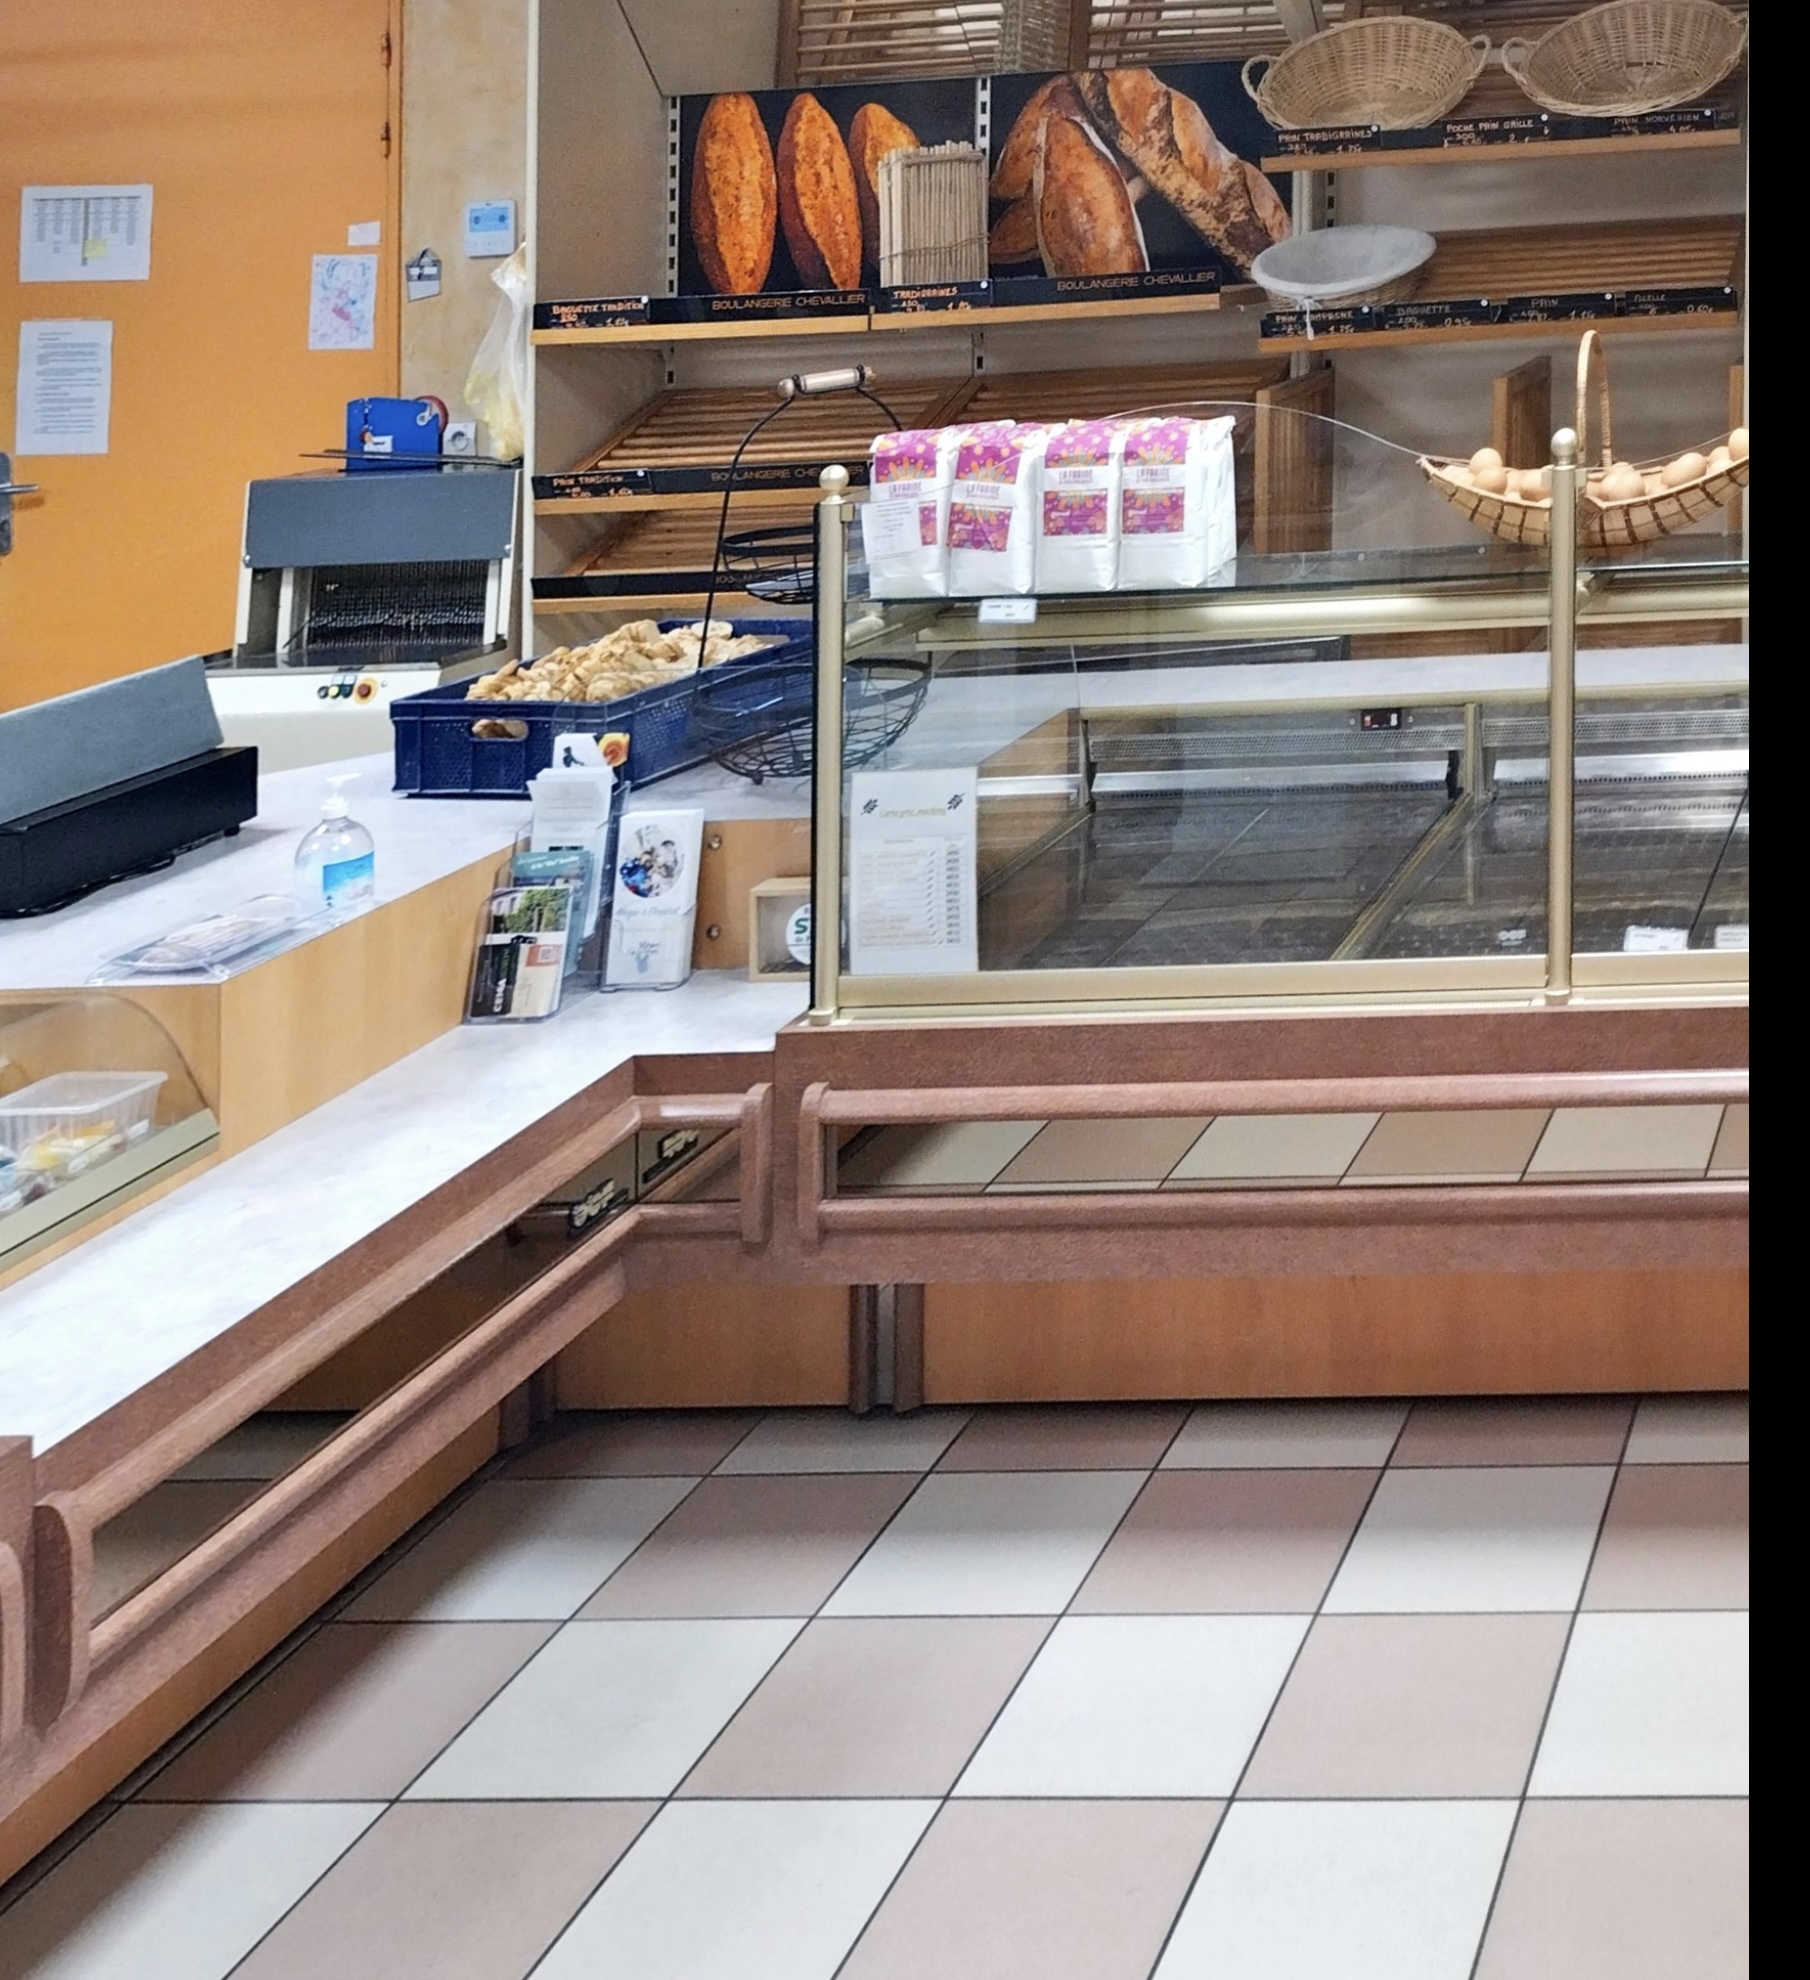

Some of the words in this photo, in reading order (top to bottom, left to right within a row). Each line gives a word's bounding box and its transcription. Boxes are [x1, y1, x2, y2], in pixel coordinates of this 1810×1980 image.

[1478, 120, 1499, 131] PAIN
[1278, 133, 1300, 143] PAIN
[1056, 276, 1140, 292] BOULANGERIE
[1143, 271, 1216, 286] CHEVALLIER
[712, 297, 792, 311] BOULANGERIE
[795, 293, 867, 307] CHEVALLIER
[1531, 298, 1559, 309] PAIN
[1396, 304, 1451, 317] BAGUETTE
